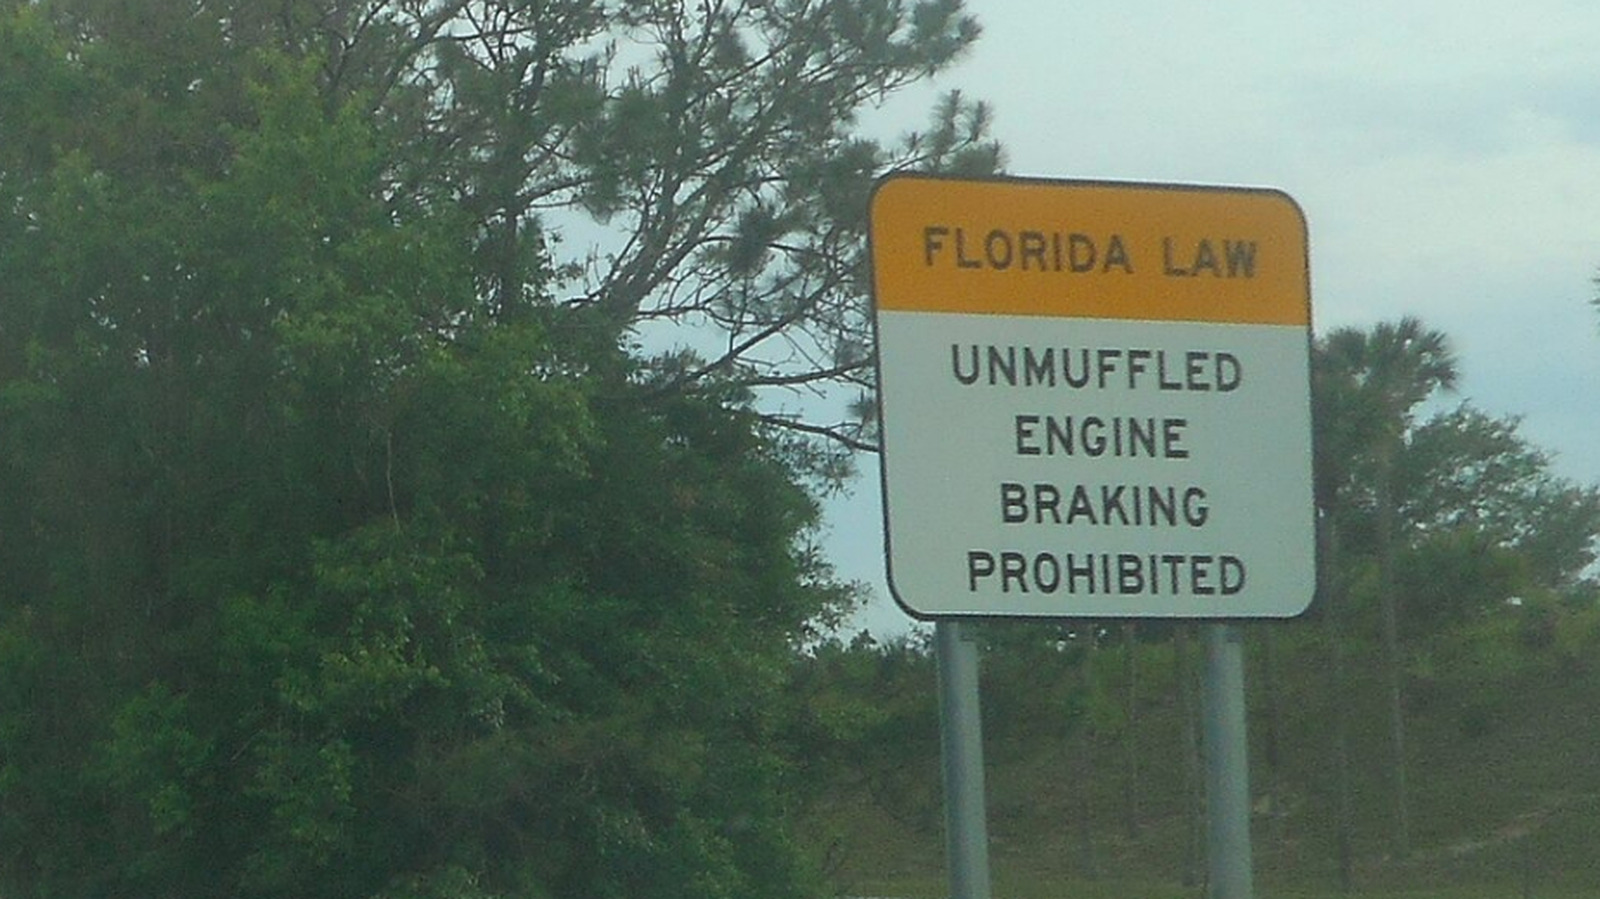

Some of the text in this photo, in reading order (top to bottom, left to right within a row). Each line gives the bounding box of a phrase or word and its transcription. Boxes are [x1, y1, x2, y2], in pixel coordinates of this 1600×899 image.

[924, 227, 1257, 279] FLORIDA LAW
[952, 344, 1242, 392] UNMUFFLED
[1016, 415, 1189, 459] ENGINE
[1001, 483, 1209, 528] BRAKING
[968, 552, 1246, 596] PROHIBITED
